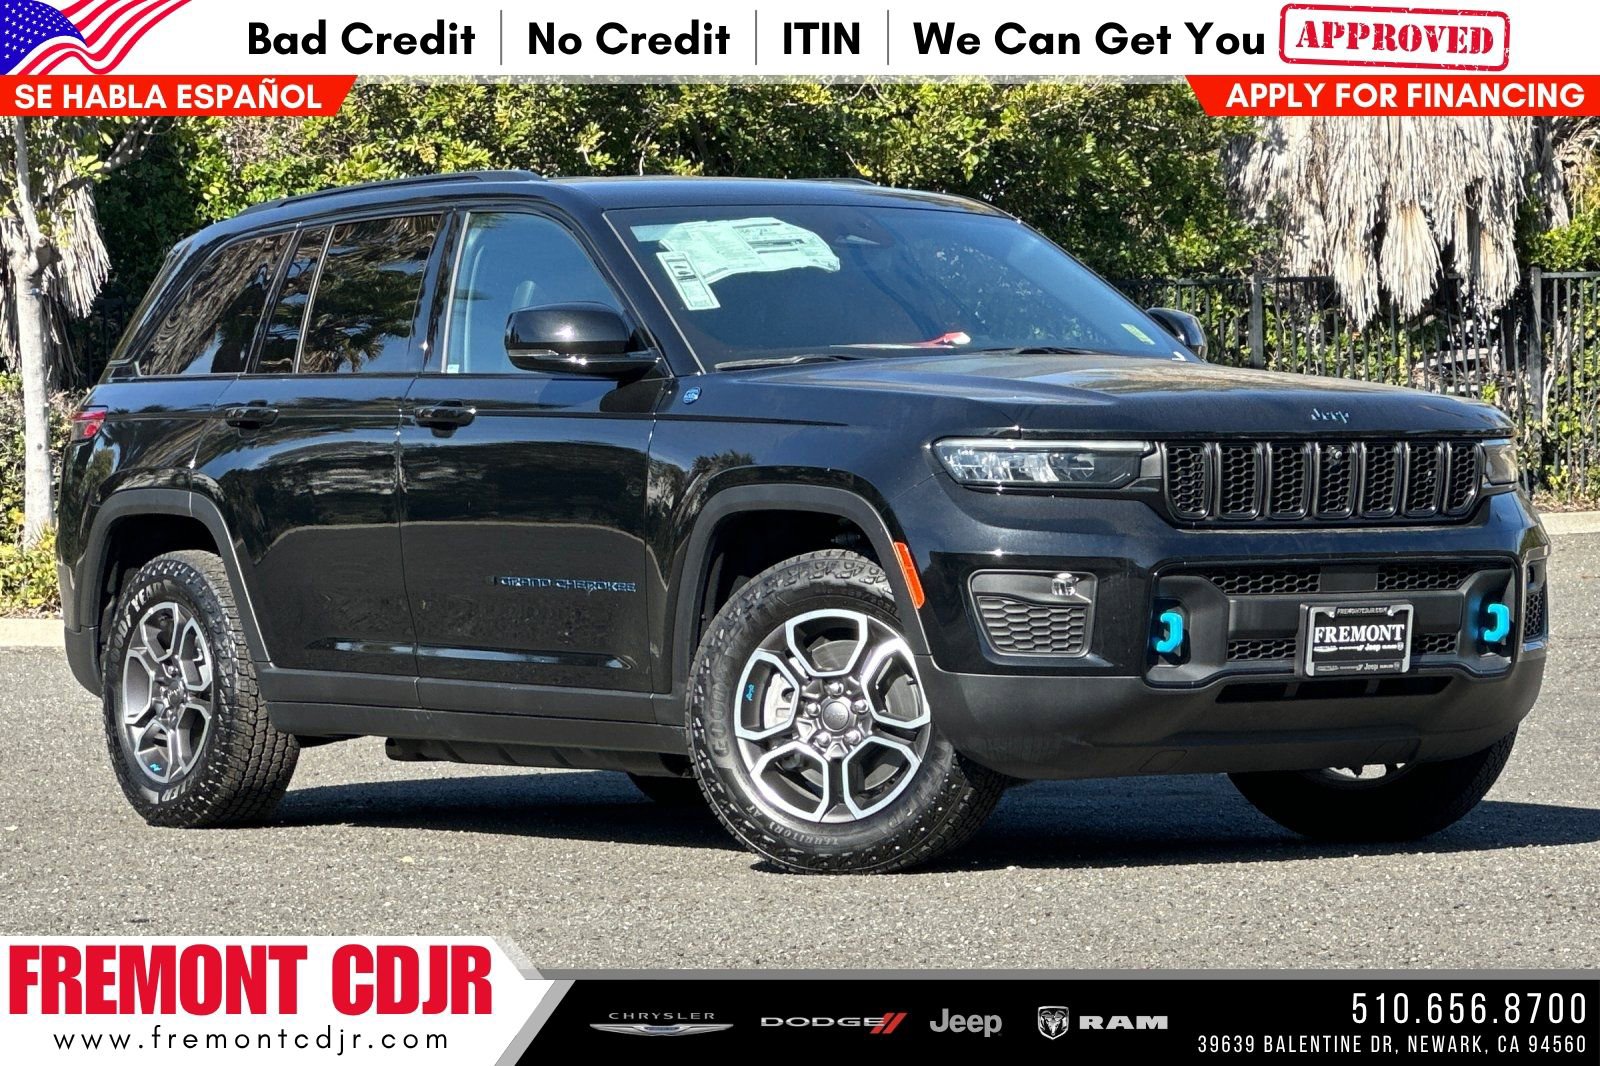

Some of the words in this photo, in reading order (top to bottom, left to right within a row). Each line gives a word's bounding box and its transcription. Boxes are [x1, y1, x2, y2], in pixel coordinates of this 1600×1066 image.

[500, 576, 552, 588] GRAND
[555, 579, 637, 593] CHEROKEE
[1313, 624, 1405, 644] FREMONT
